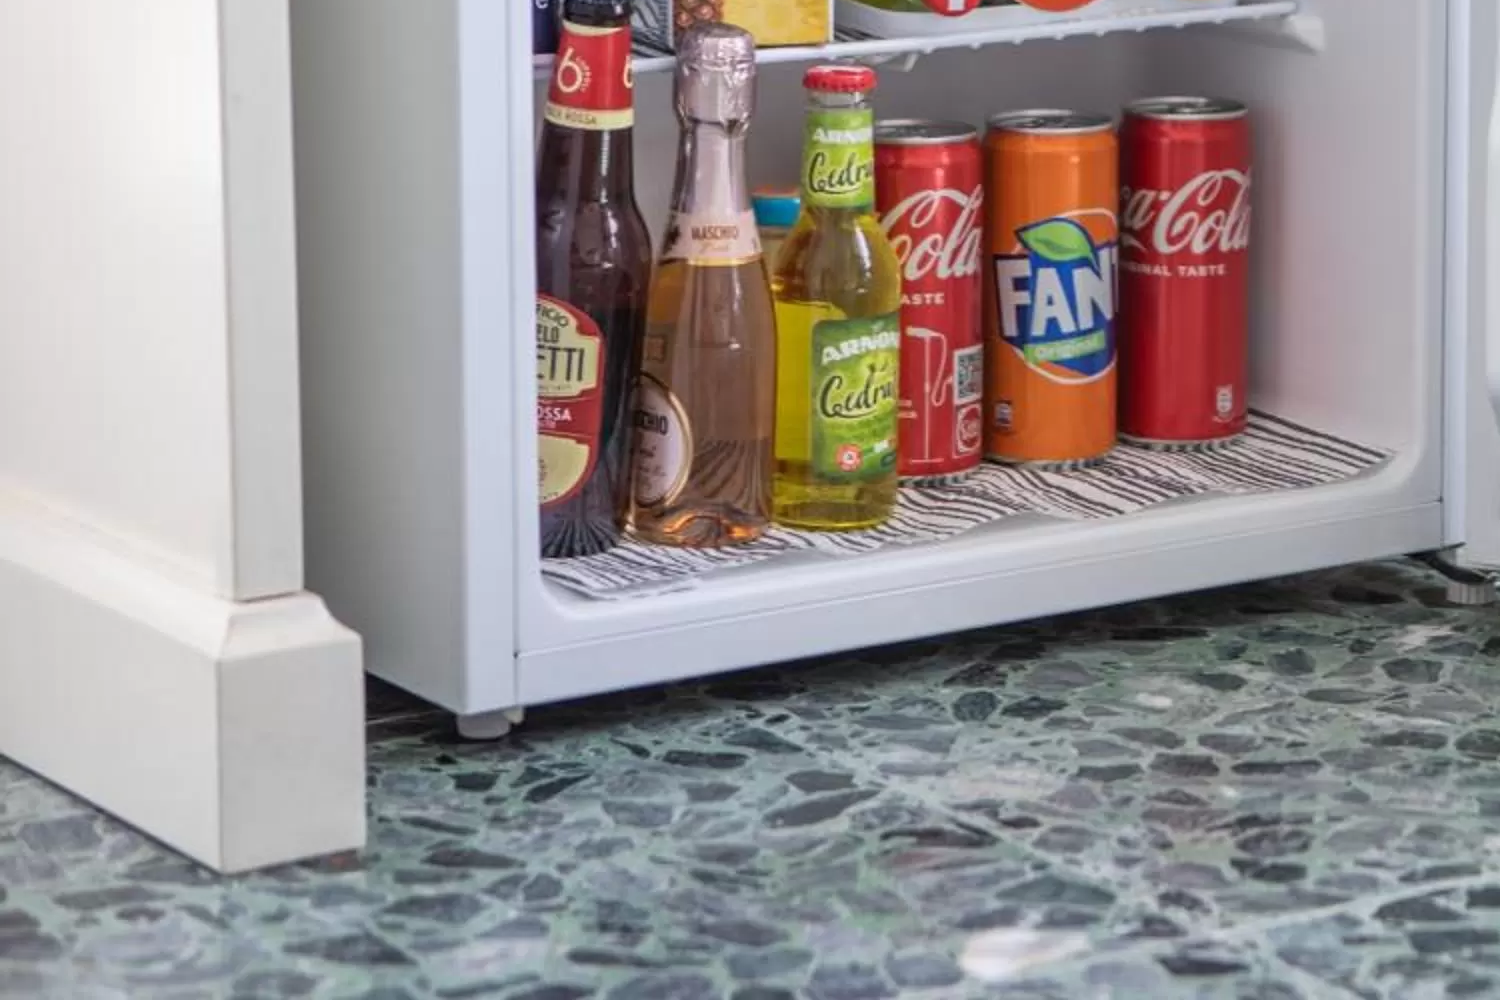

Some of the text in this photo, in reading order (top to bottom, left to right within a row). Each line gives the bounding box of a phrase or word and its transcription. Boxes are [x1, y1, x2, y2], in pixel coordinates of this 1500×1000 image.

[557, 45, 583, 93] 6
[995, 246, 1119, 338] FAN
[1177, 263, 1226, 277] TASTE
